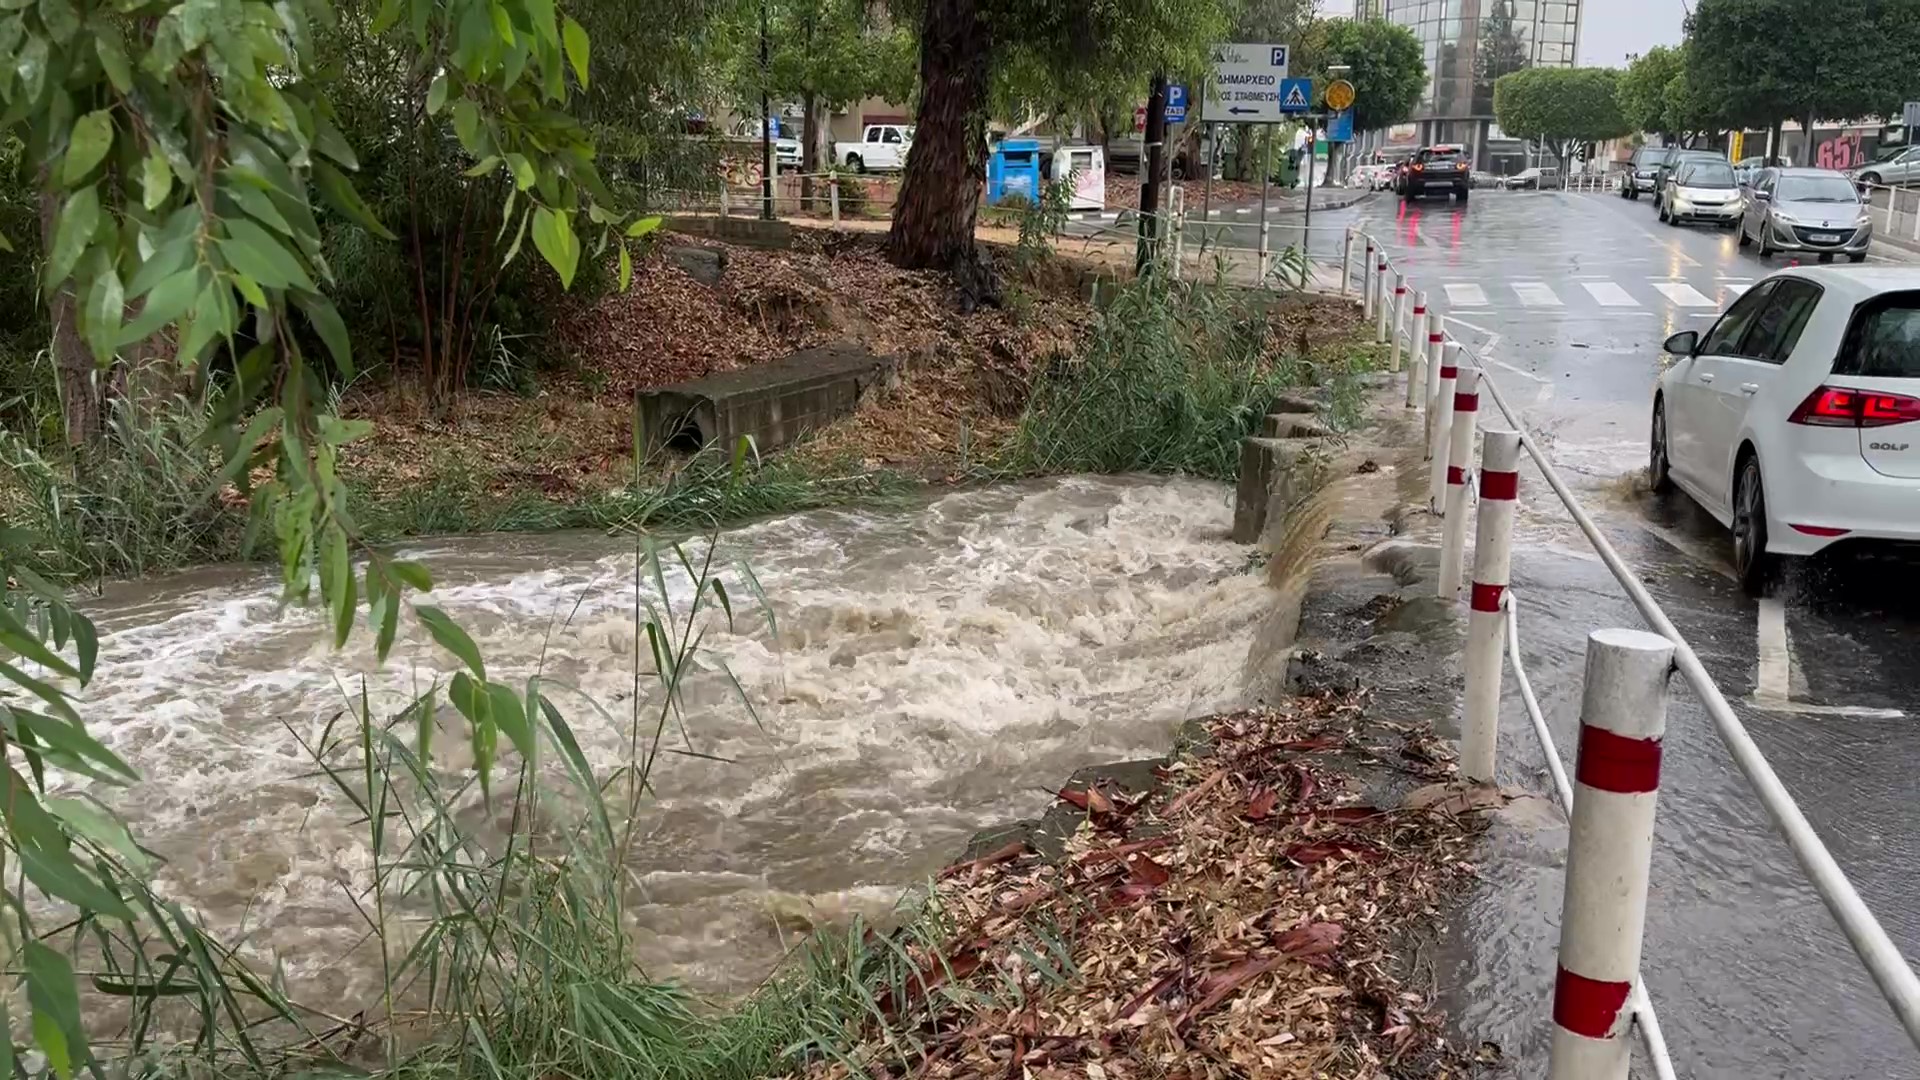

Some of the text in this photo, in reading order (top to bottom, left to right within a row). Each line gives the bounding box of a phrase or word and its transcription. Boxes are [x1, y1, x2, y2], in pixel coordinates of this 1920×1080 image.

[1273, 49, 1283, 65] P
[1169, 87, 1182, 104] P
[1235, 91, 1280, 102] ΣΤΑΘΜΕΥΣΗ
[1818, 129, 1865, 169] 65%
[1869, 442, 1909, 451] GOLF
